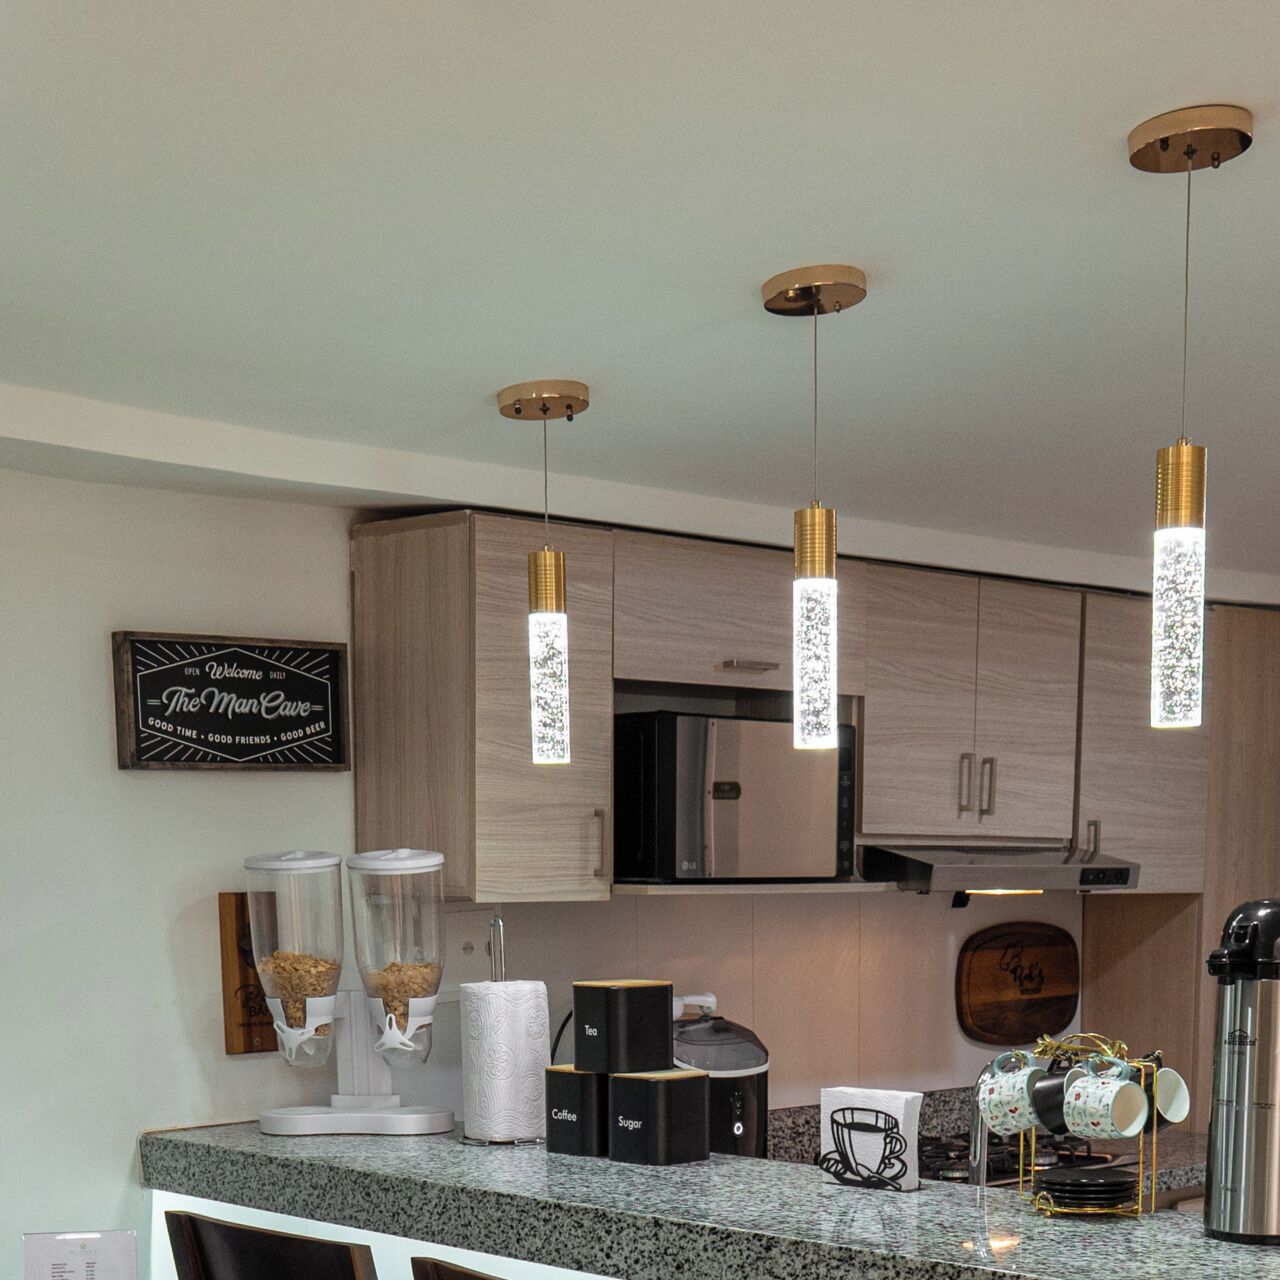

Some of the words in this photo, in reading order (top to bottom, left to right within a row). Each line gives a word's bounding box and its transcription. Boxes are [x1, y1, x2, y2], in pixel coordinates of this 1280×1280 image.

[184, 667, 200, 676] OPEN
[205, 661, 263, 680] Welcome
[270, 671, 286, 679] DAILY
[162, 686, 201, 717] The
[200, 687, 260, 719] Man
[259, 690, 311, 719] Cave
[148, 717, 174, 732] GOOD
[176, 726, 198, 738] TIME
[208, 733, 233, 744] GOOD
[235, 735, 271, 744] FRIENDS
[280, 730, 304, 742] GOOD
[305, 721, 326, 735] BEER
[584, 1025, 598, 1036] Tea
[551, 1108, 577, 1122] Coffee
[618, 1116, 643, 1130] Sugar
